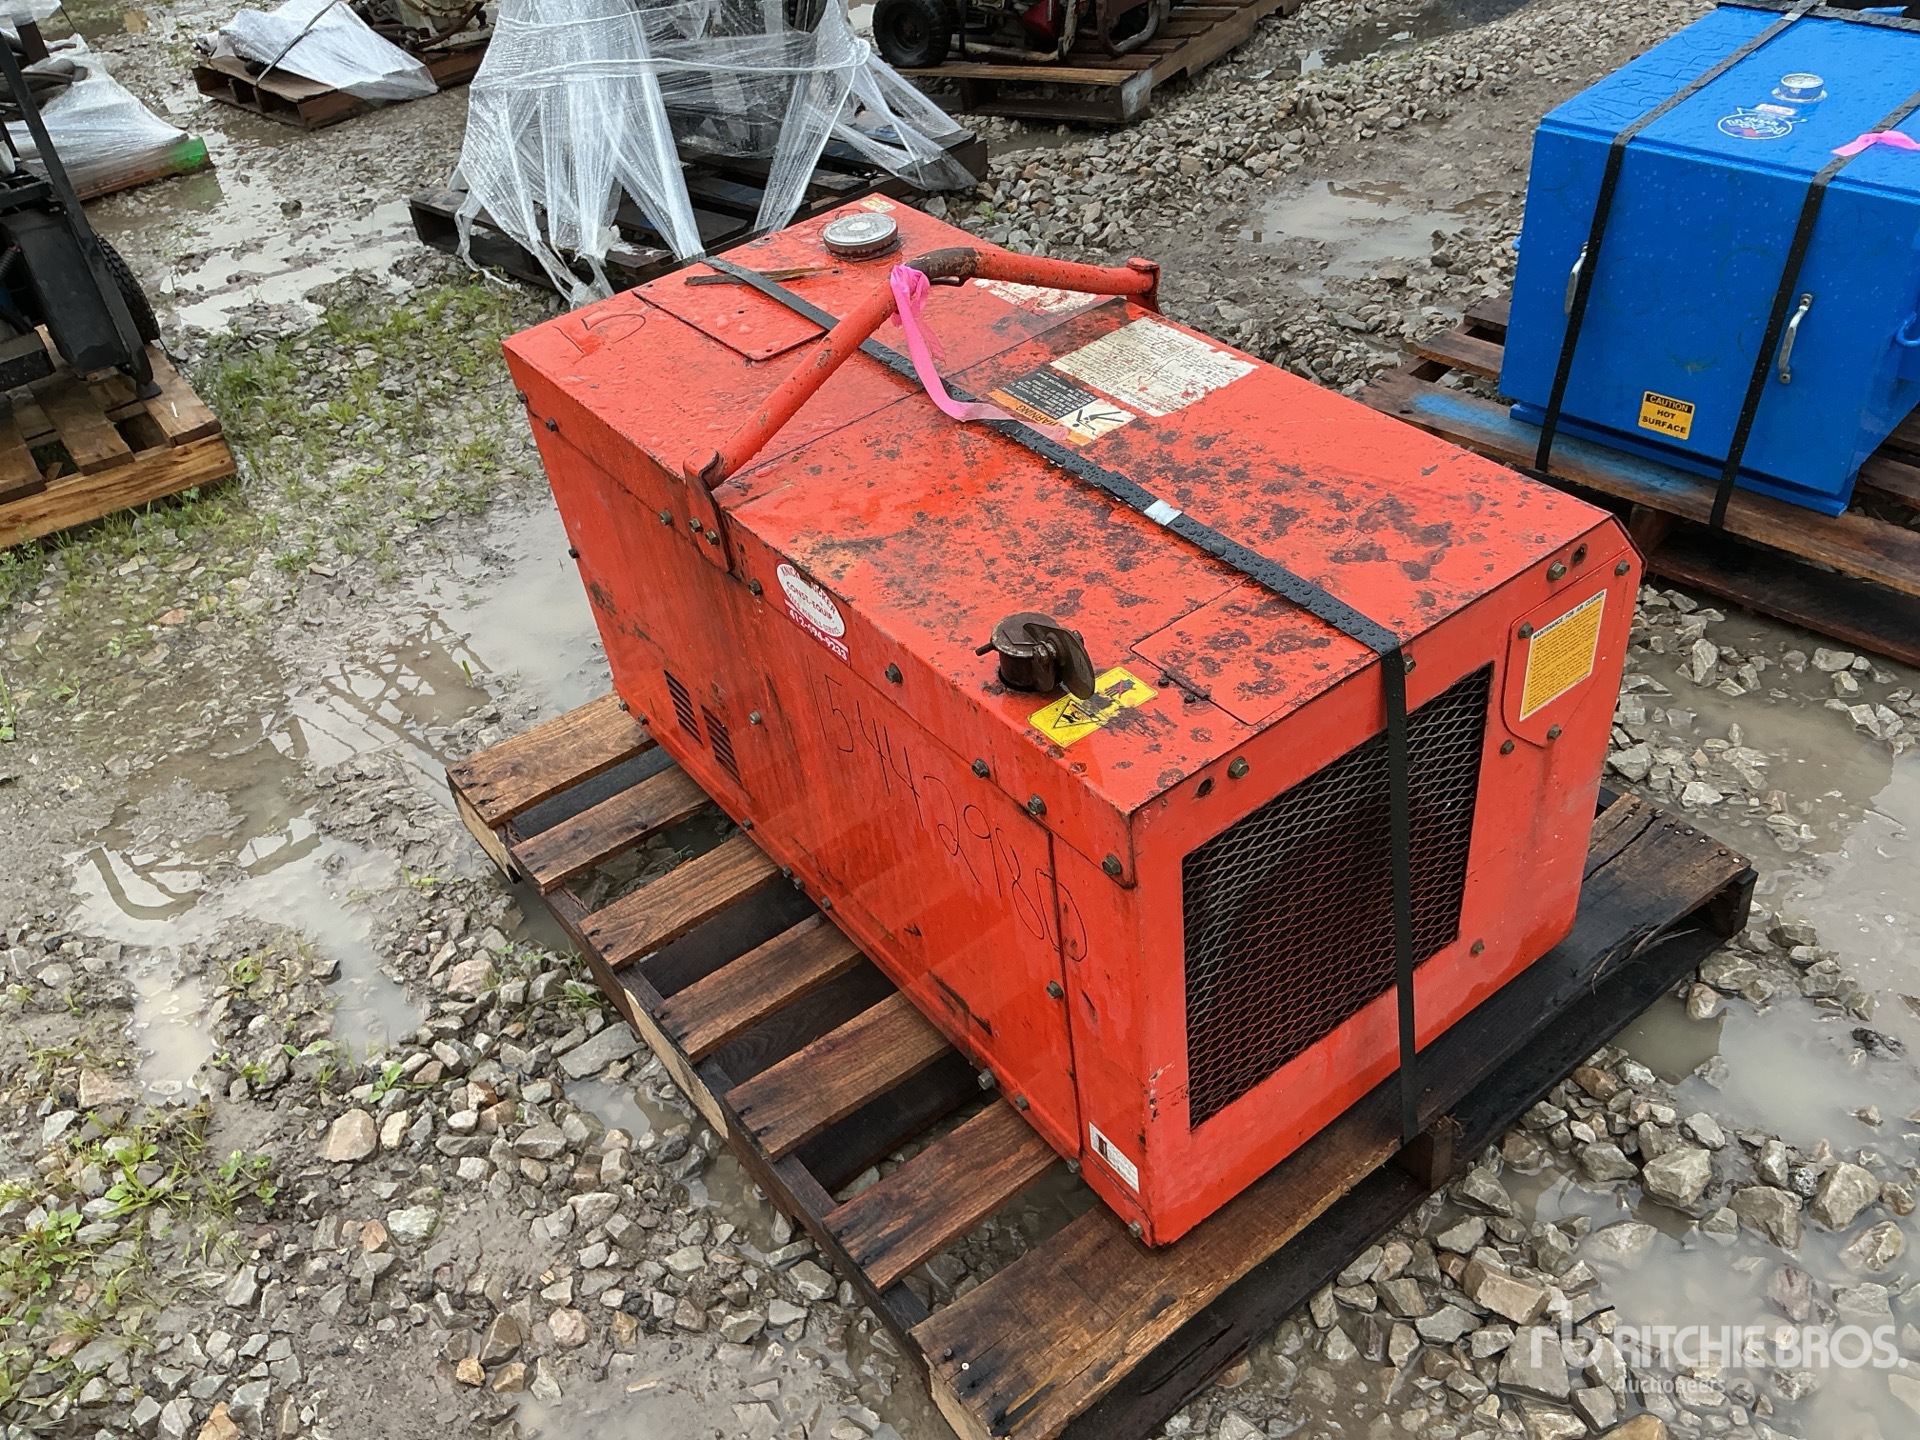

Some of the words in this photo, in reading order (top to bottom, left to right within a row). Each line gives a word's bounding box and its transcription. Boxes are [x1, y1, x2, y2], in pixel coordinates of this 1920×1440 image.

[1649, 395, 1689, 412] CAUTION
[1656, 409, 1676, 420] HOT
[1642, 415, 1687, 433] SURFACE
